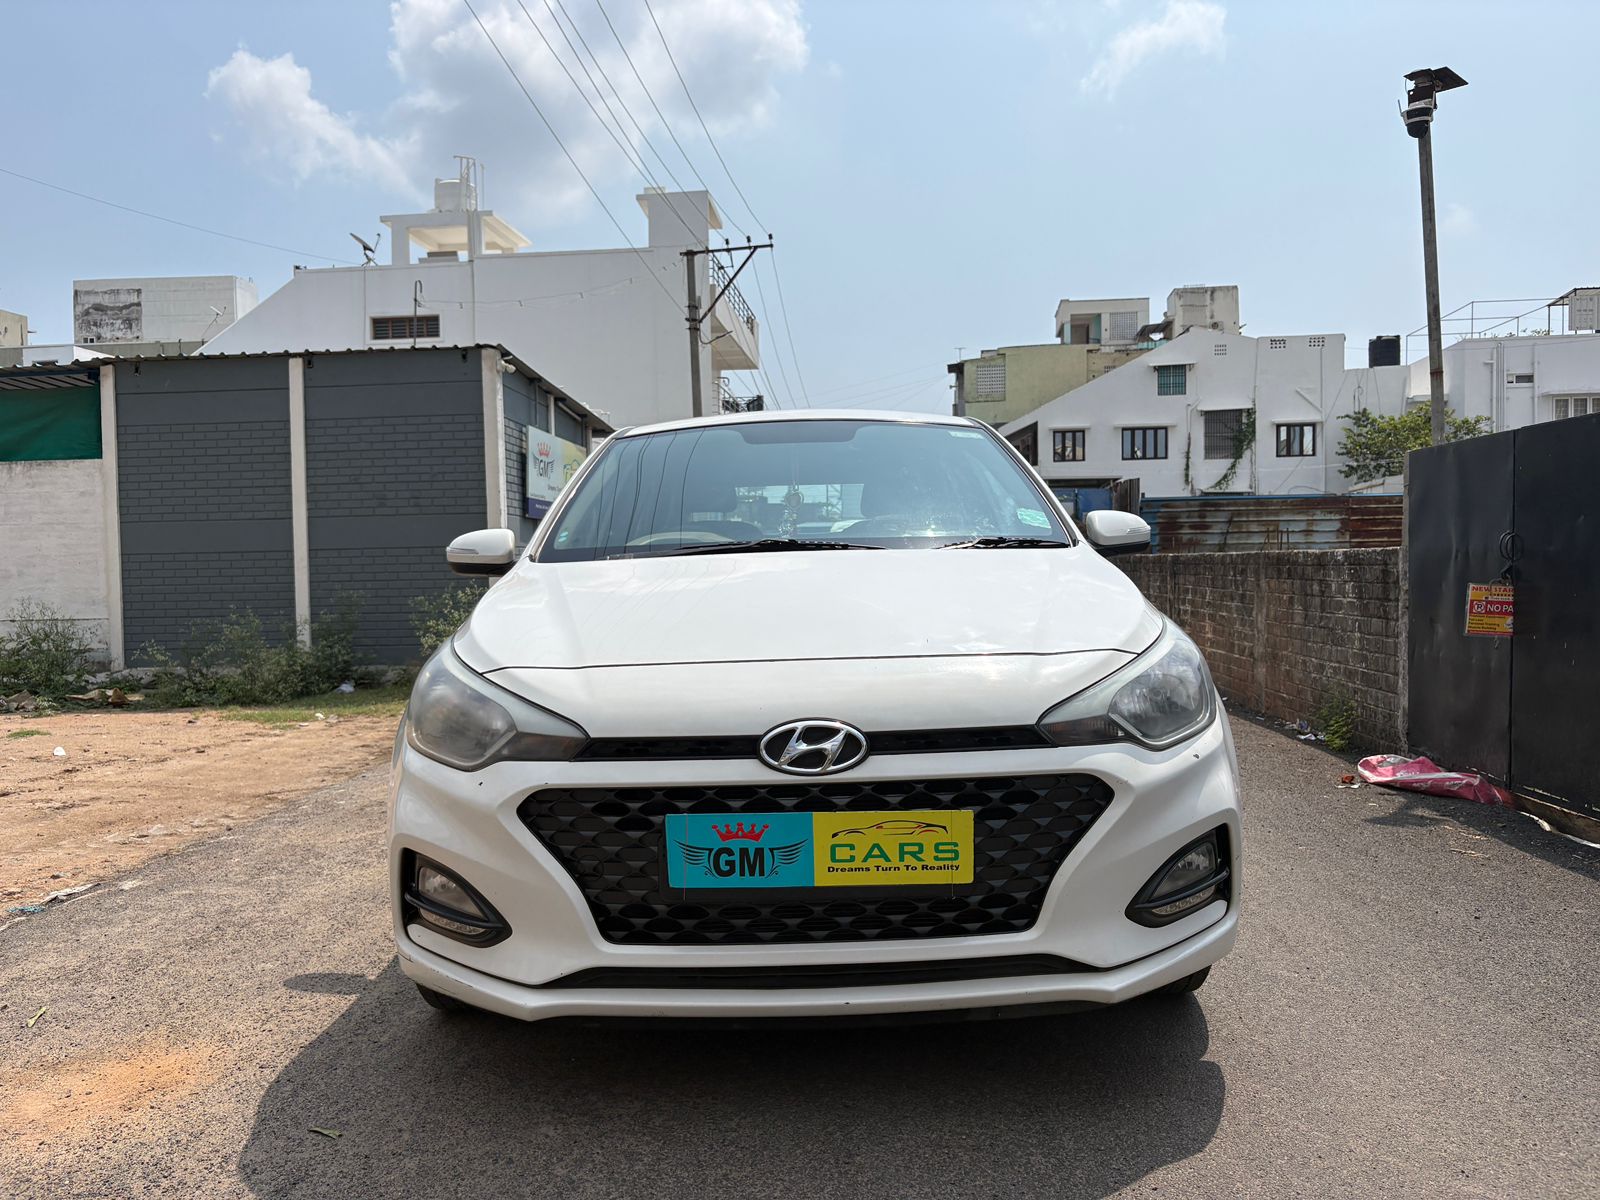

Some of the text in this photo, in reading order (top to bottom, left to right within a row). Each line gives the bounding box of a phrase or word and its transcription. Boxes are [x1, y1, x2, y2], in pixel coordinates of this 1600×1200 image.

[538, 459, 549, 478] GM
[1487, 604, 1501, 612] NO
[830, 841, 960, 863] CARS
[712, 847, 765, 878] GM
[827, 865, 871, 873] Dreams
[873, 864, 900, 872] Turn
[921, 863, 960, 872] Reality
